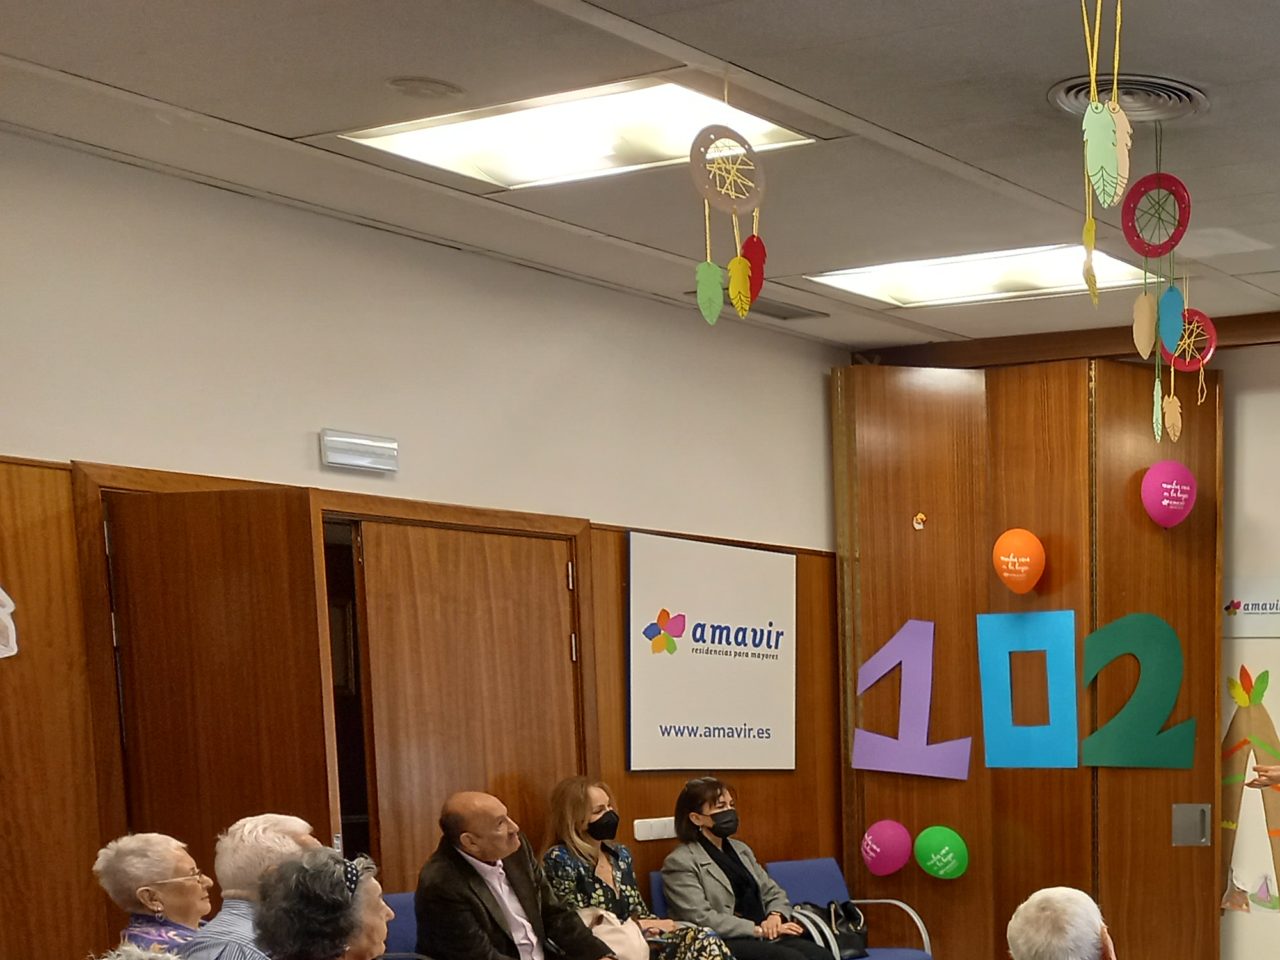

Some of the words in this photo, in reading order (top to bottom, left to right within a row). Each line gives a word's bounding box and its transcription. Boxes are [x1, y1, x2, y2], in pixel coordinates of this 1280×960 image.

[692, 621, 784, 649] amavir
[691, 647, 732, 656] residencias
[734, 650, 749, 658] para
[751, 652, 778, 660] mayores
[659, 723, 771, 740] www.amavir.es
